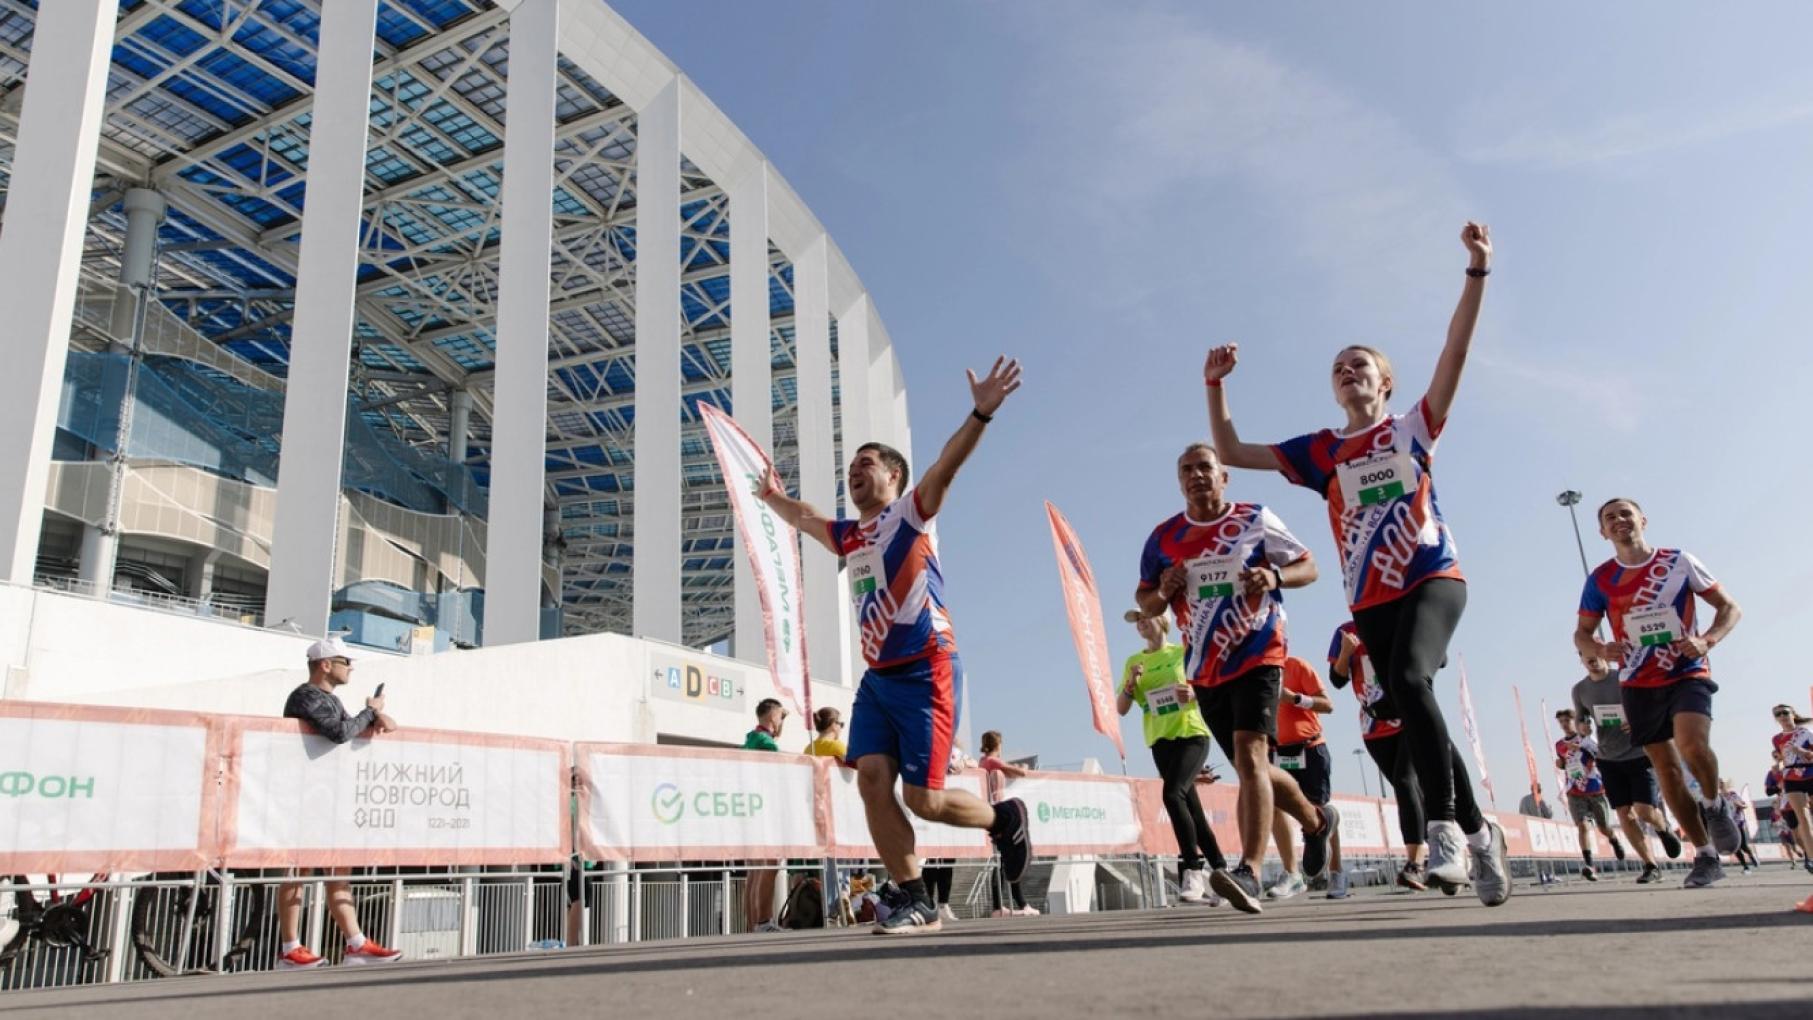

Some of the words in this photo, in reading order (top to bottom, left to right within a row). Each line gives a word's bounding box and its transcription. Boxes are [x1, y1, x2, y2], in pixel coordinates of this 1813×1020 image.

[1361, 469, 1394, 485] 8000
[1200, 571, 1227, 582] 9177
[1640, 622, 1666, 633] 6529
[687, 665, 701, 697] D
[356, 761, 463, 784] НИЖНИЙ
[355, 785, 470, 810] НОВГОРОД
[694, 791, 764, 817] СБЕР
